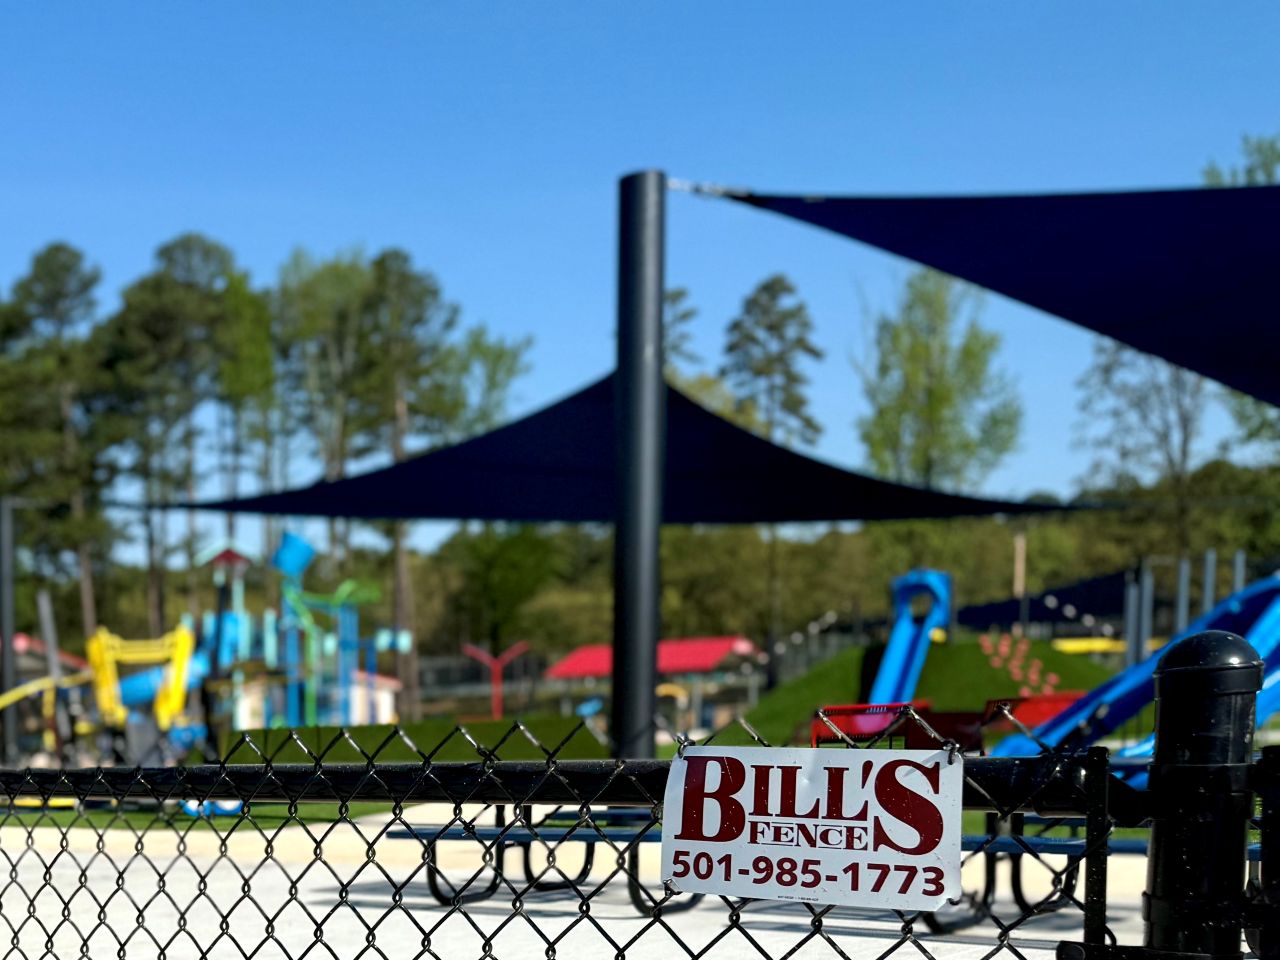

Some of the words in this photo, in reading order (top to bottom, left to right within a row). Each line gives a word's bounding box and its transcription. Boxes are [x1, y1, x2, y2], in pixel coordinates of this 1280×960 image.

[674, 756, 944, 856] BILL'S
[747, 821, 869, 851] FENCE
[671, 850, 945, 897] 501-985-1773
